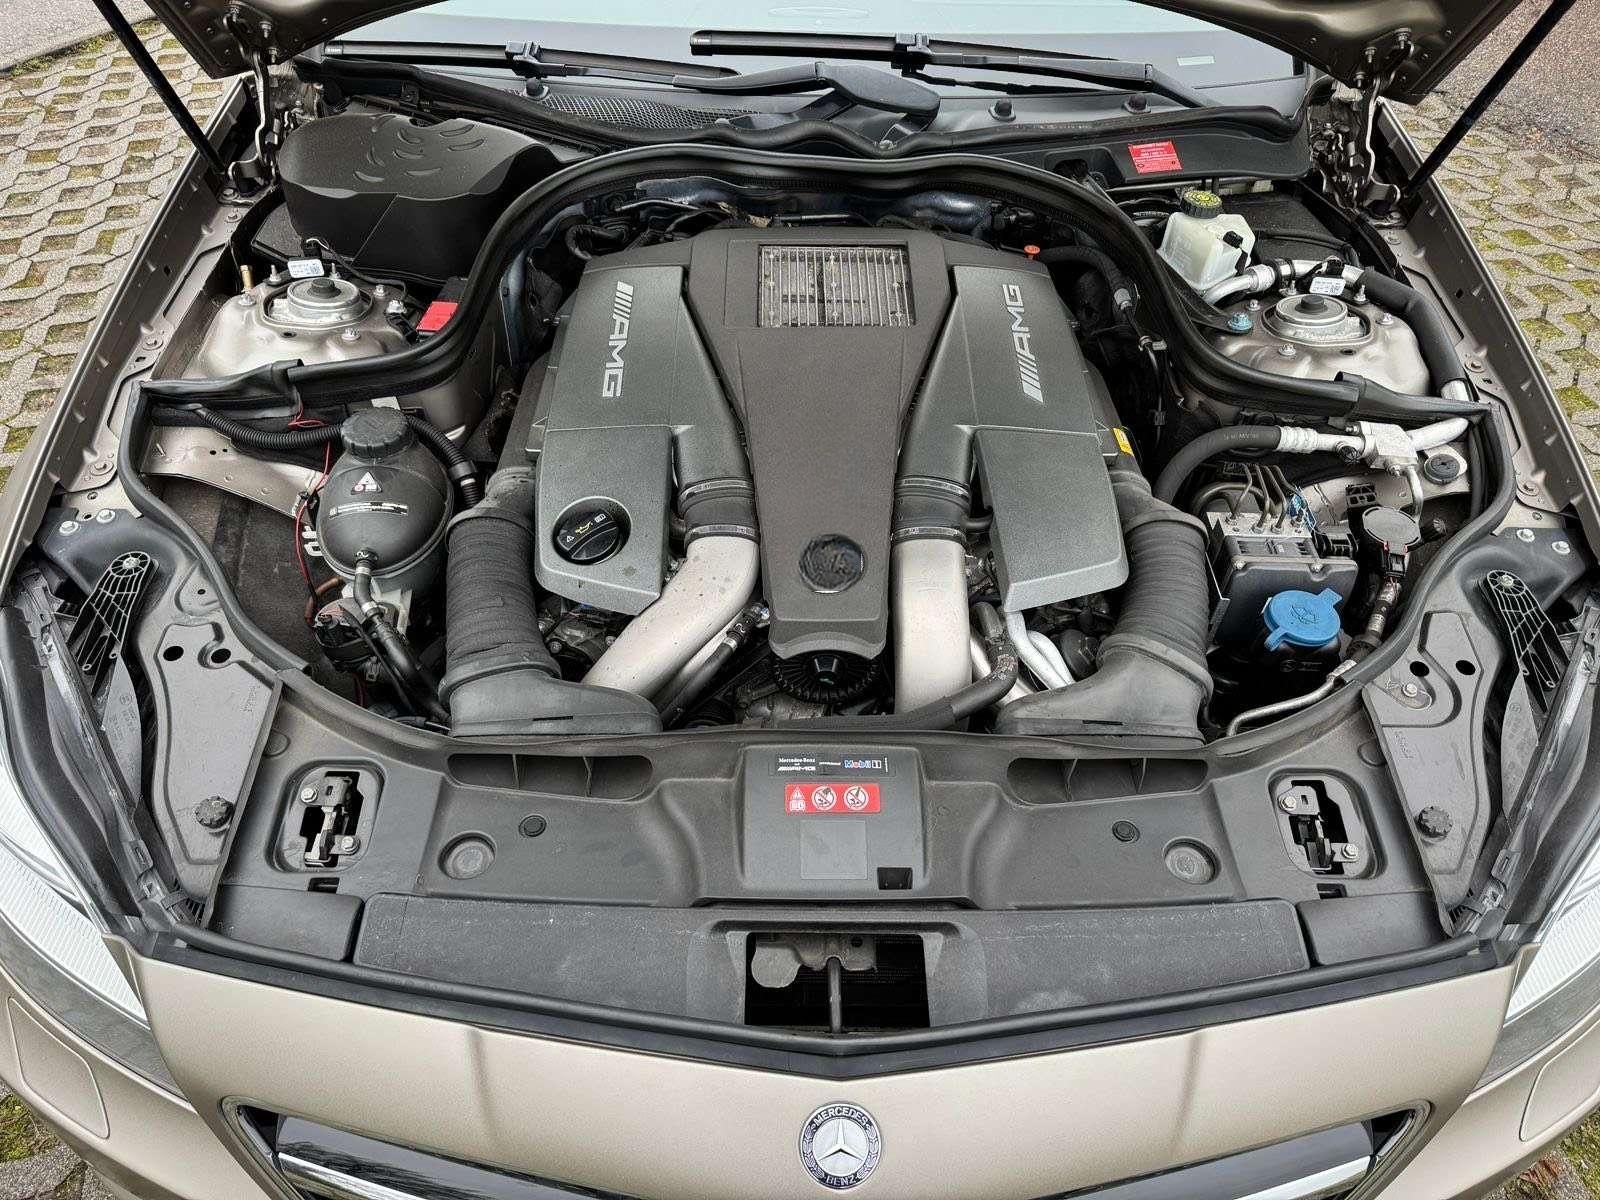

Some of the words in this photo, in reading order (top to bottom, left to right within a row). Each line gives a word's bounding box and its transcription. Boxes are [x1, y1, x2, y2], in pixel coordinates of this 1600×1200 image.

[1002, 284, 1035, 361] AMG
[603, 312, 630, 397] AMG
[844, 760, 871, 768] Mobil
[812, 1106, 869, 1126] MERCEDES
[825, 1175, 857, 1186] BENZ
